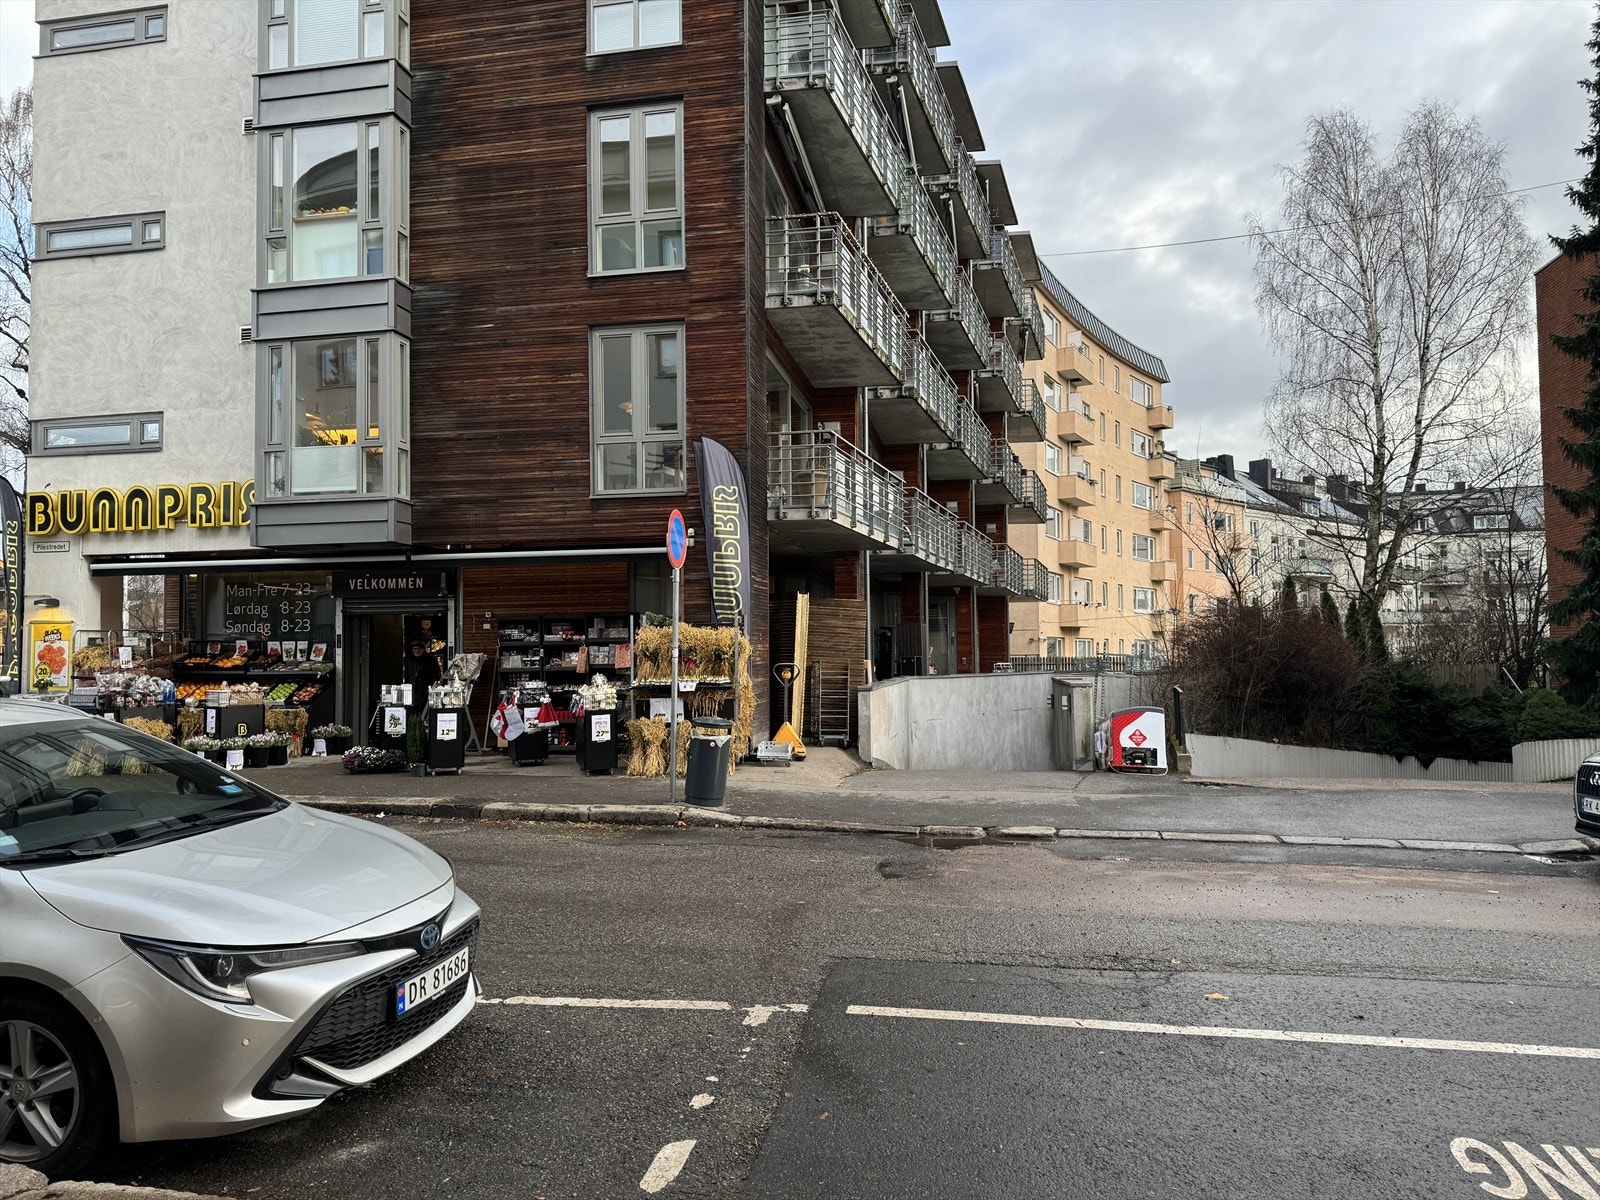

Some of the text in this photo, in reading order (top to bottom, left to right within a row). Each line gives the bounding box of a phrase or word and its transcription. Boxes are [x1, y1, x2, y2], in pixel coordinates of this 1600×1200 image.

[36, 543, 66, 551] Pilestredet
[226, 583, 311, 597] Man-Fre 7-23
[349, 577, 424, 590] VELKOMMEN
[226, 601, 311, 618] Lørdag 8-23
[226, 619, 311, 636] Søndag 8-23
[409, 951, 466, 1005] DR 81686
[1450, 1137, 1600, 1200] ING
